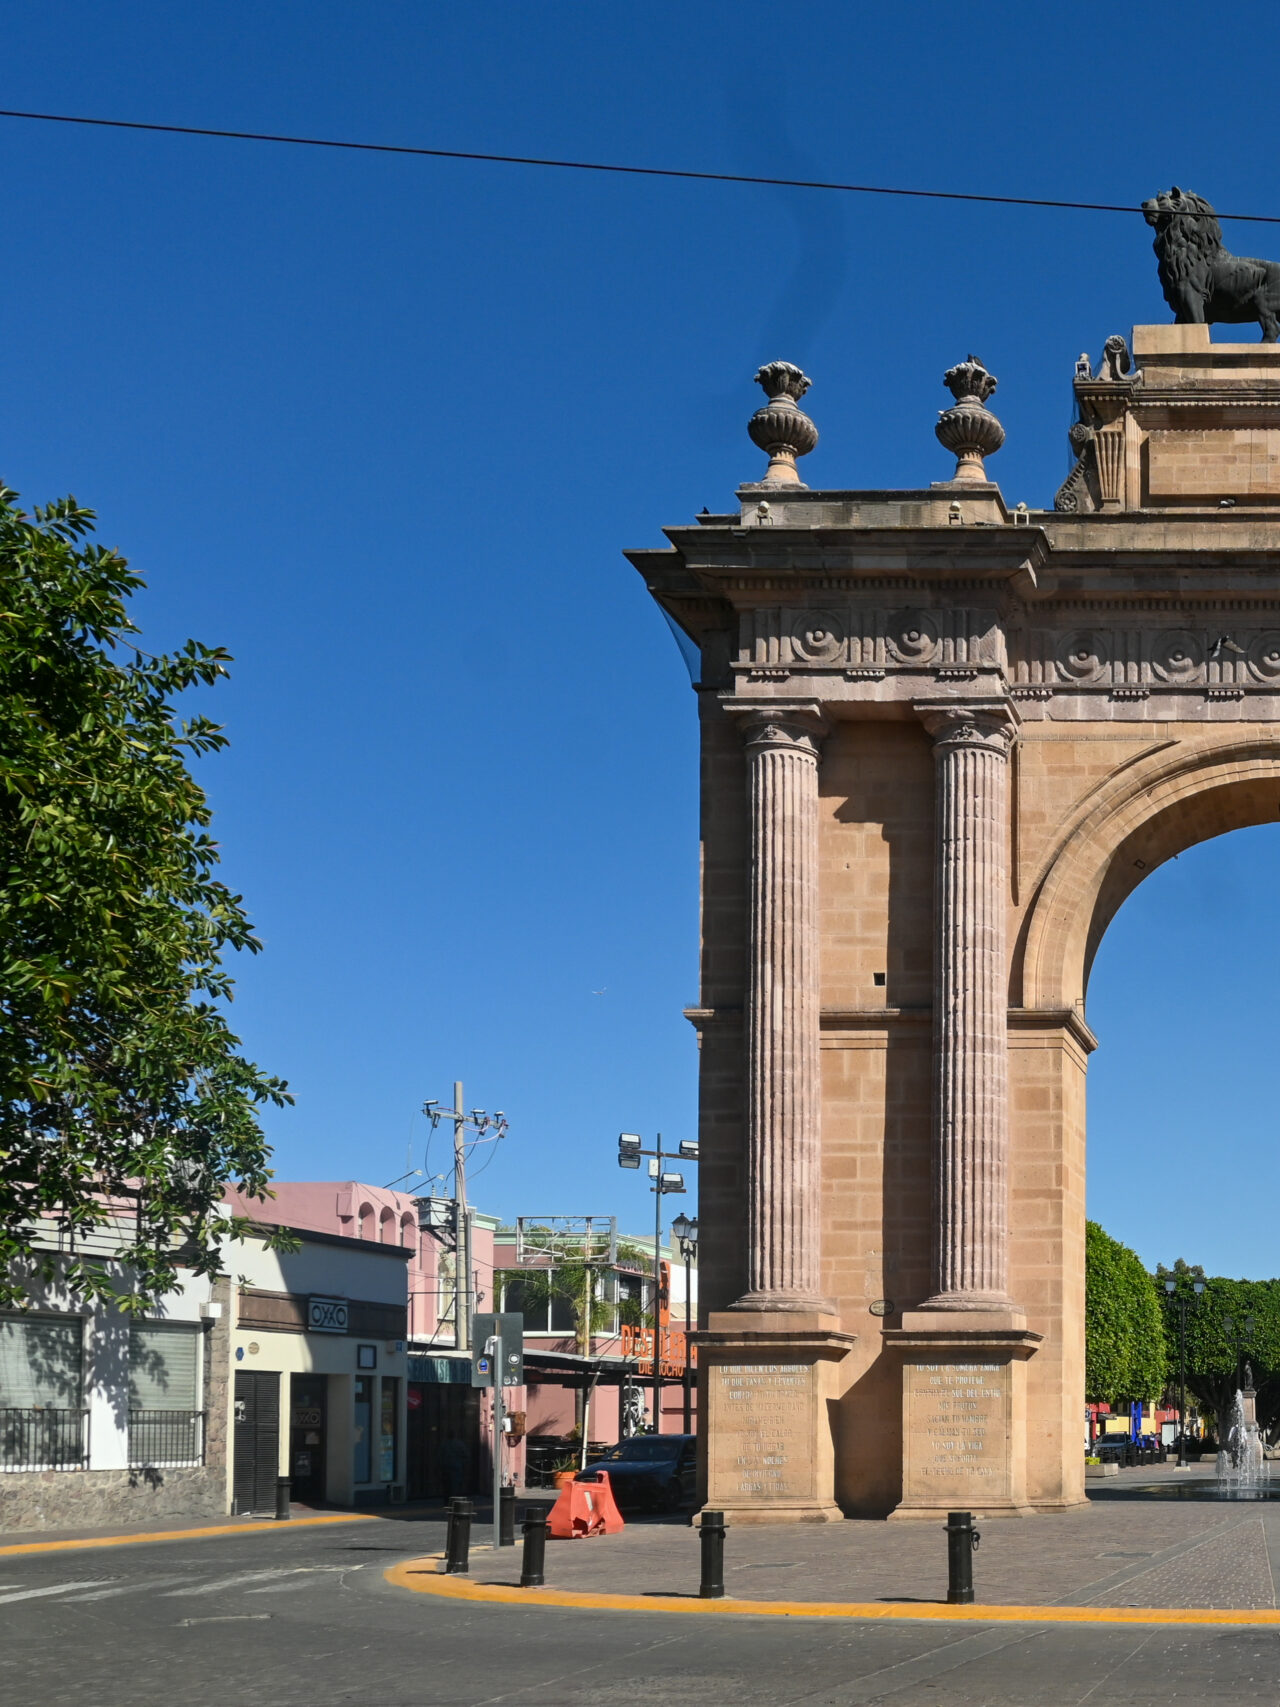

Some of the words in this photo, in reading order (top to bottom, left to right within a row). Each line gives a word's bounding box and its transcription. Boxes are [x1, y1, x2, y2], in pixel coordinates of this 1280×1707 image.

[311, 1304, 347, 1327] OXXO
[621, 1324, 698, 1361] DESTILERA
[638, 1360, 684, 1377] DIEIOCHO
[294, 1412, 320, 1425] XXO
